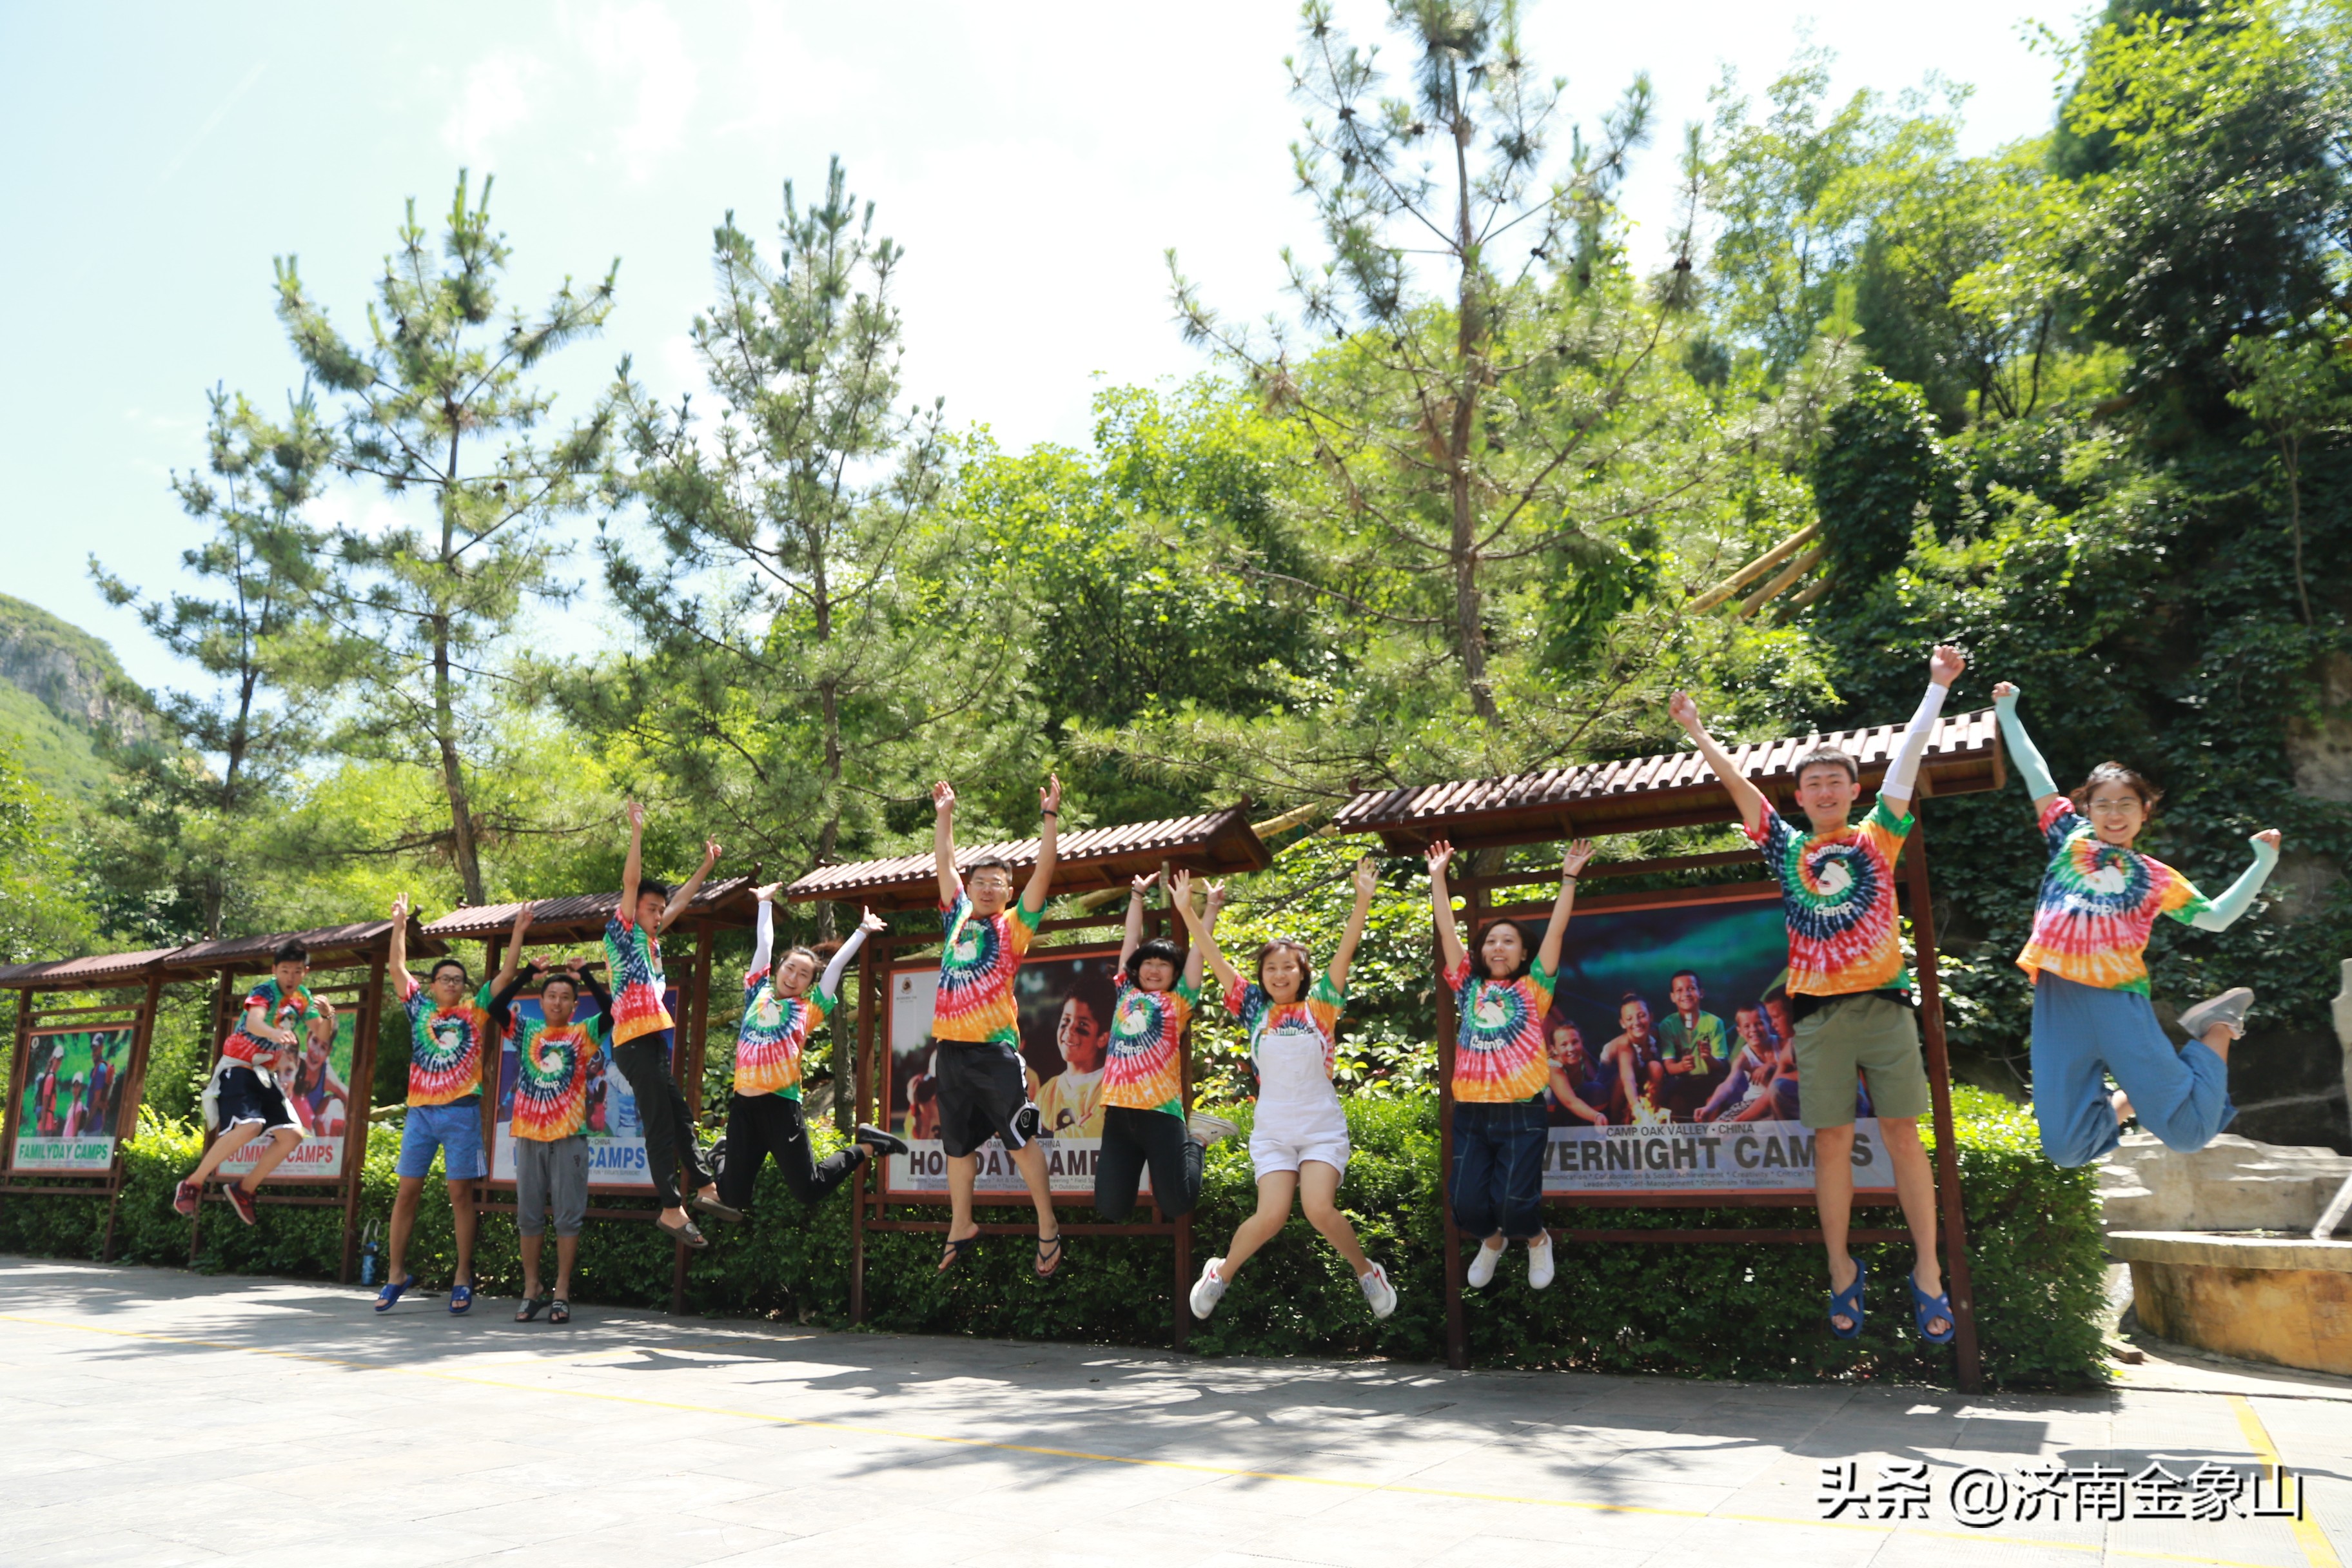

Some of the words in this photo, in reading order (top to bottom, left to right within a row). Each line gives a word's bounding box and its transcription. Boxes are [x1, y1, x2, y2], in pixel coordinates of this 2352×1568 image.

[1806, 844, 1853, 863] Summe
[1814, 901, 1853, 917] Camp
[746, 1030, 773, 1044] Camp
[1471, 1034, 1505, 1051] Camp
[1115, 1040, 1144, 1055] Camp
[534, 1077, 560, 1090] Camp
[1607, 1127, 1638, 1137] CAMP
[1641, 1126, 1665, 1135] OAK
[1667, 1125, 1708, 1135] VALLEY
[1718, 1124, 1755, 1133] CHINA
[19, 1144, 73, 1159] FAMILYDAY
[74, 1144, 108, 1160] CAMPS
[227, 1145, 266, 1162] SUMM
[286, 1145, 333, 1163] CAMPS
[1542, 1137, 1721, 1171] VERNIGHT
[1734, 1133, 1874, 1170] CAMS
[910, 1151, 1017, 1175] HODAY
[1732, 1170, 1769, 1179] Creativity
[1777, 1170, 1805, 1178] Critical
[1630, 1179, 1694, 1188] Self-Management
[1702, 1179, 1738, 1187] Optimism
